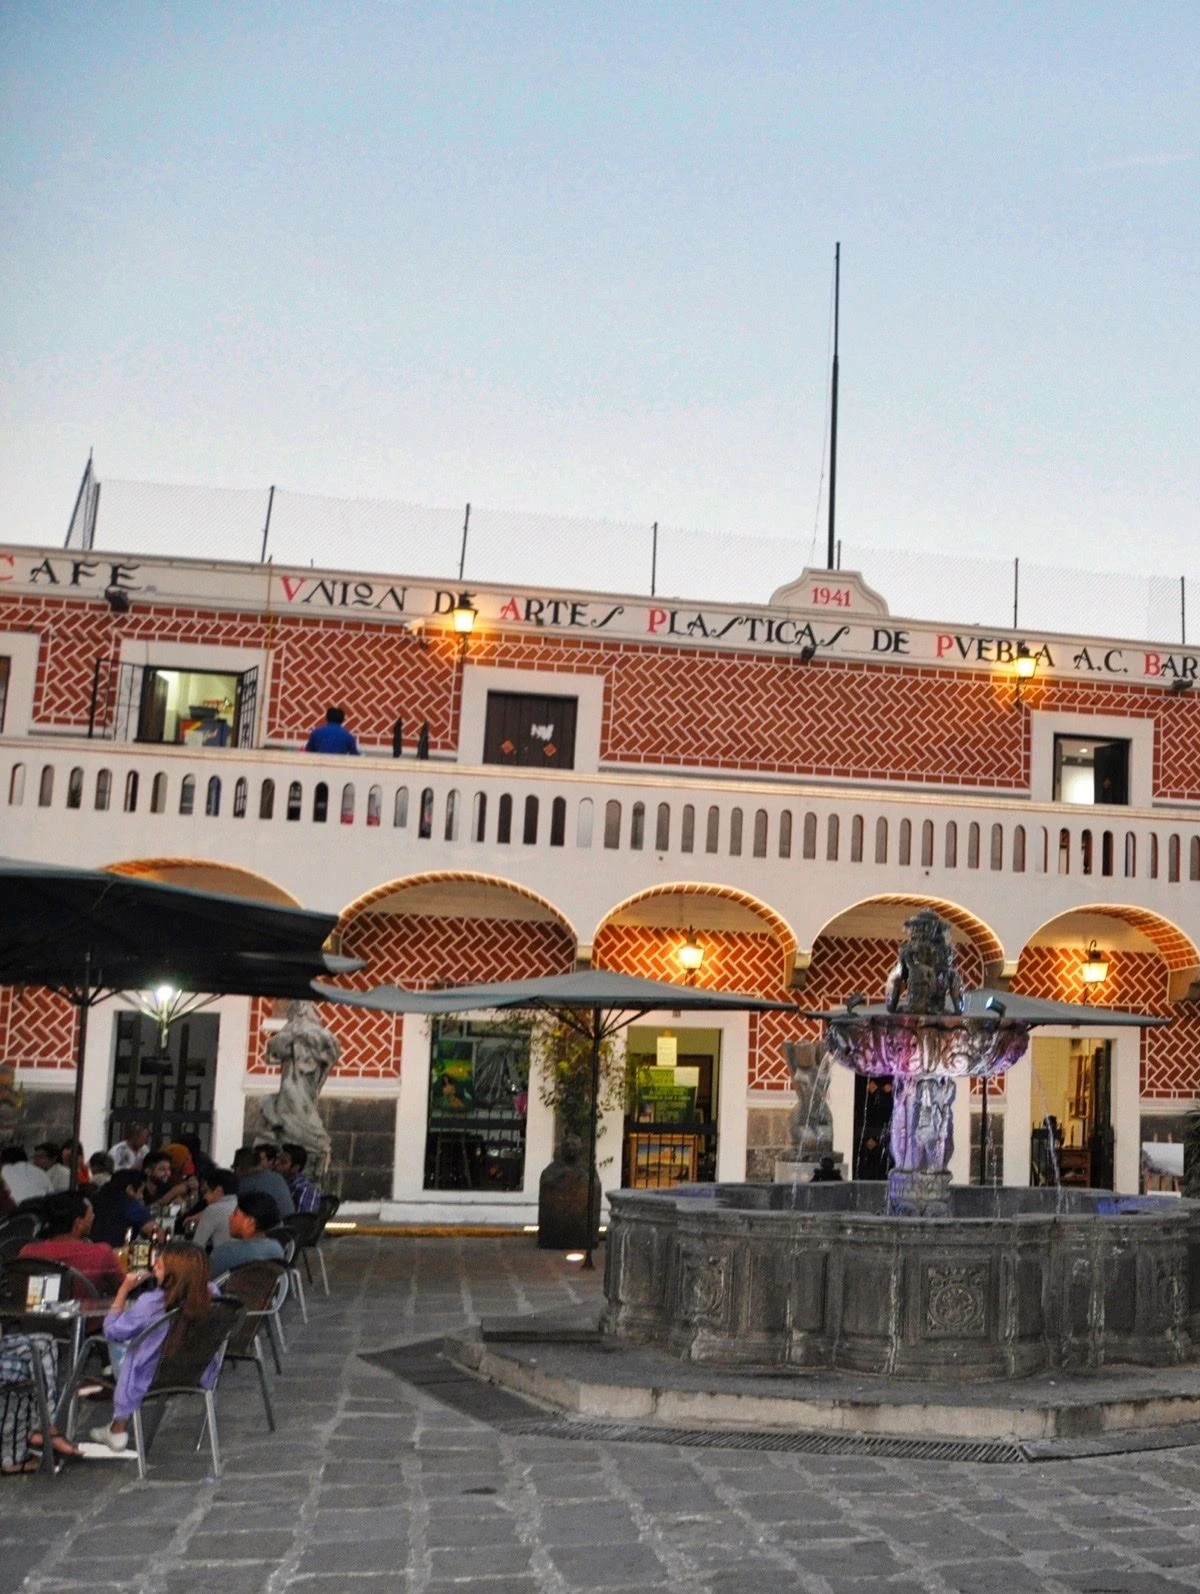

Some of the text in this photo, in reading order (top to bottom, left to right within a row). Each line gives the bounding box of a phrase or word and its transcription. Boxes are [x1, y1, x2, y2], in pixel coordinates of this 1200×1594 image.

[811, 586, 852, 608] 1941
[499, 596, 625, 628] ARTES
[647, 607, 850, 647] PLASTICAS
[871, 628, 911, 655] DE
[1073, 645, 1129, 675] A.C.
